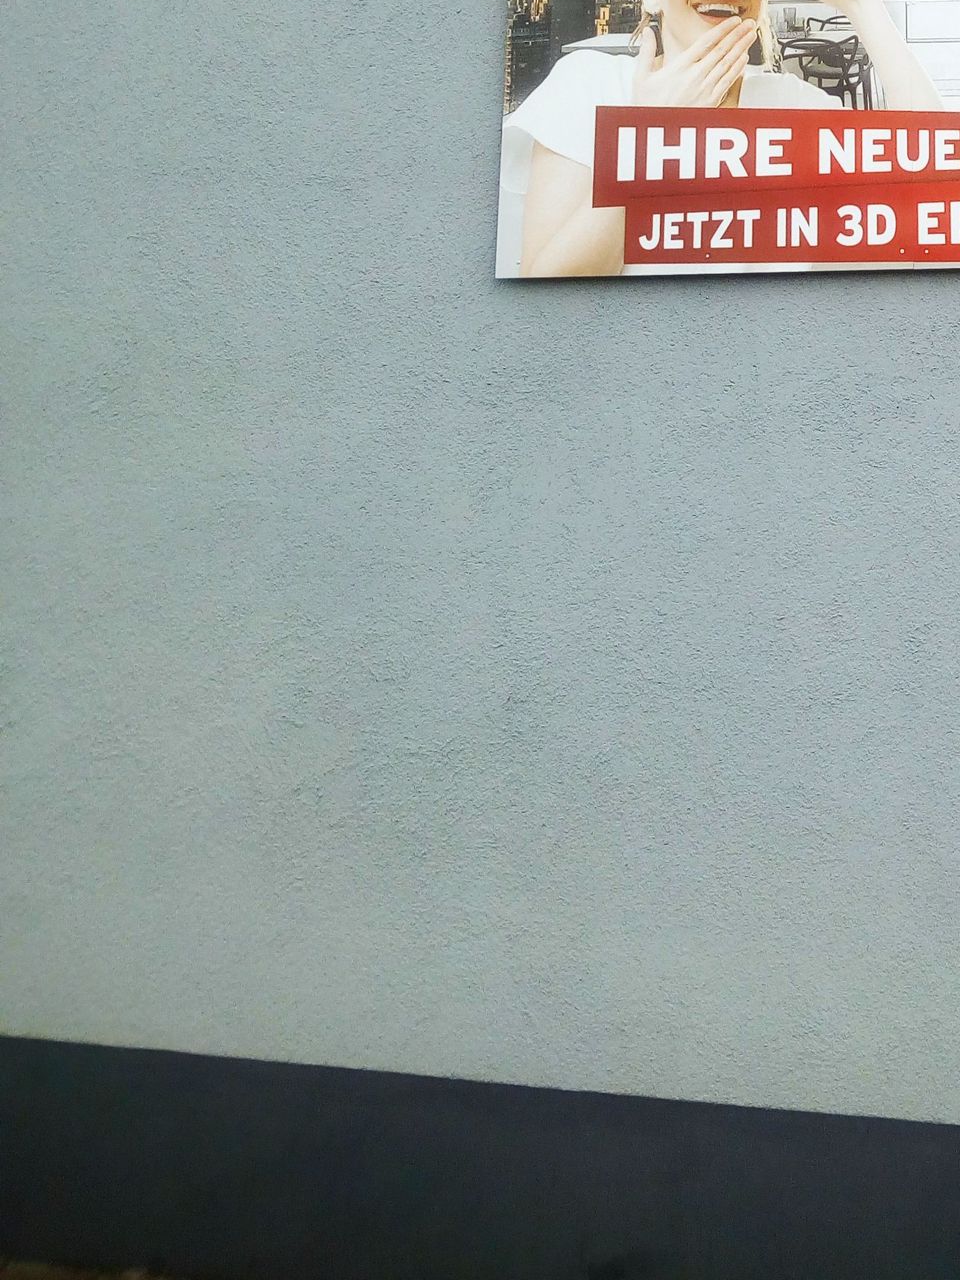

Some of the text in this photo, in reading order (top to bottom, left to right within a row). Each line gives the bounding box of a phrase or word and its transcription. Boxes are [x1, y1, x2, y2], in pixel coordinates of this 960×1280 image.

[615, 126, 794, 183] IHRE
[638, 208, 761, 250] JETZT
[776, 206, 819, 247] IN
[836, 203, 897, 246] 3D
